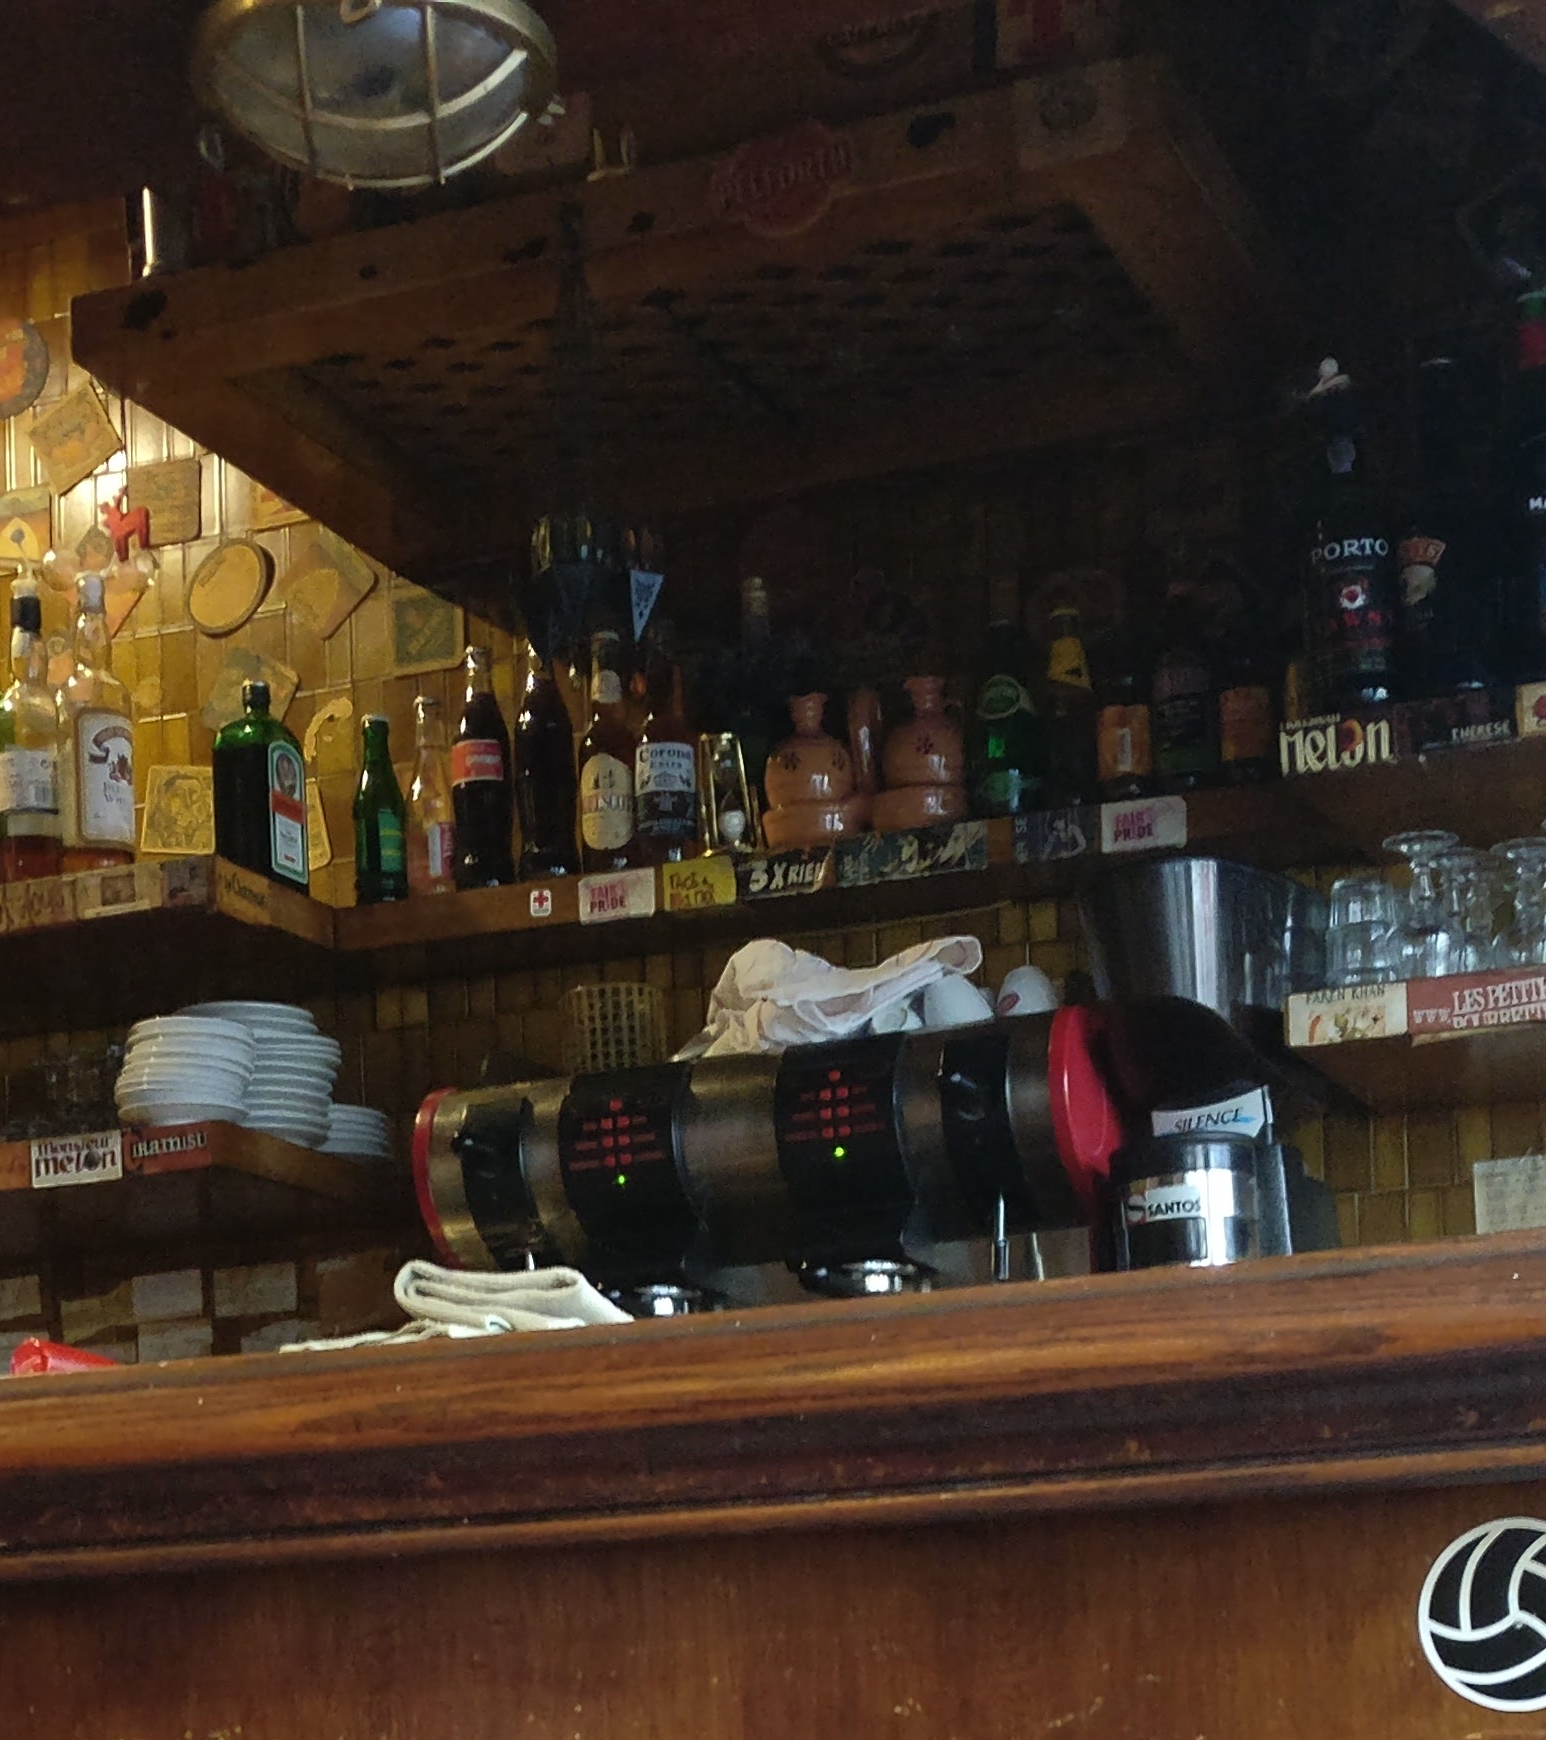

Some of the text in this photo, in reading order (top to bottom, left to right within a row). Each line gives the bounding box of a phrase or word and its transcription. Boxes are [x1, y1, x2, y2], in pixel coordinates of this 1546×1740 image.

[1310, 537, 1390, 566] PORTO
[1113, 823, 1153, 843] PRIDE
[589, 895, 627, 914] PRIDE
[1173, 1106, 1244, 1133] SILENCE
[1147, 1199, 1201, 1216] SANTOS
